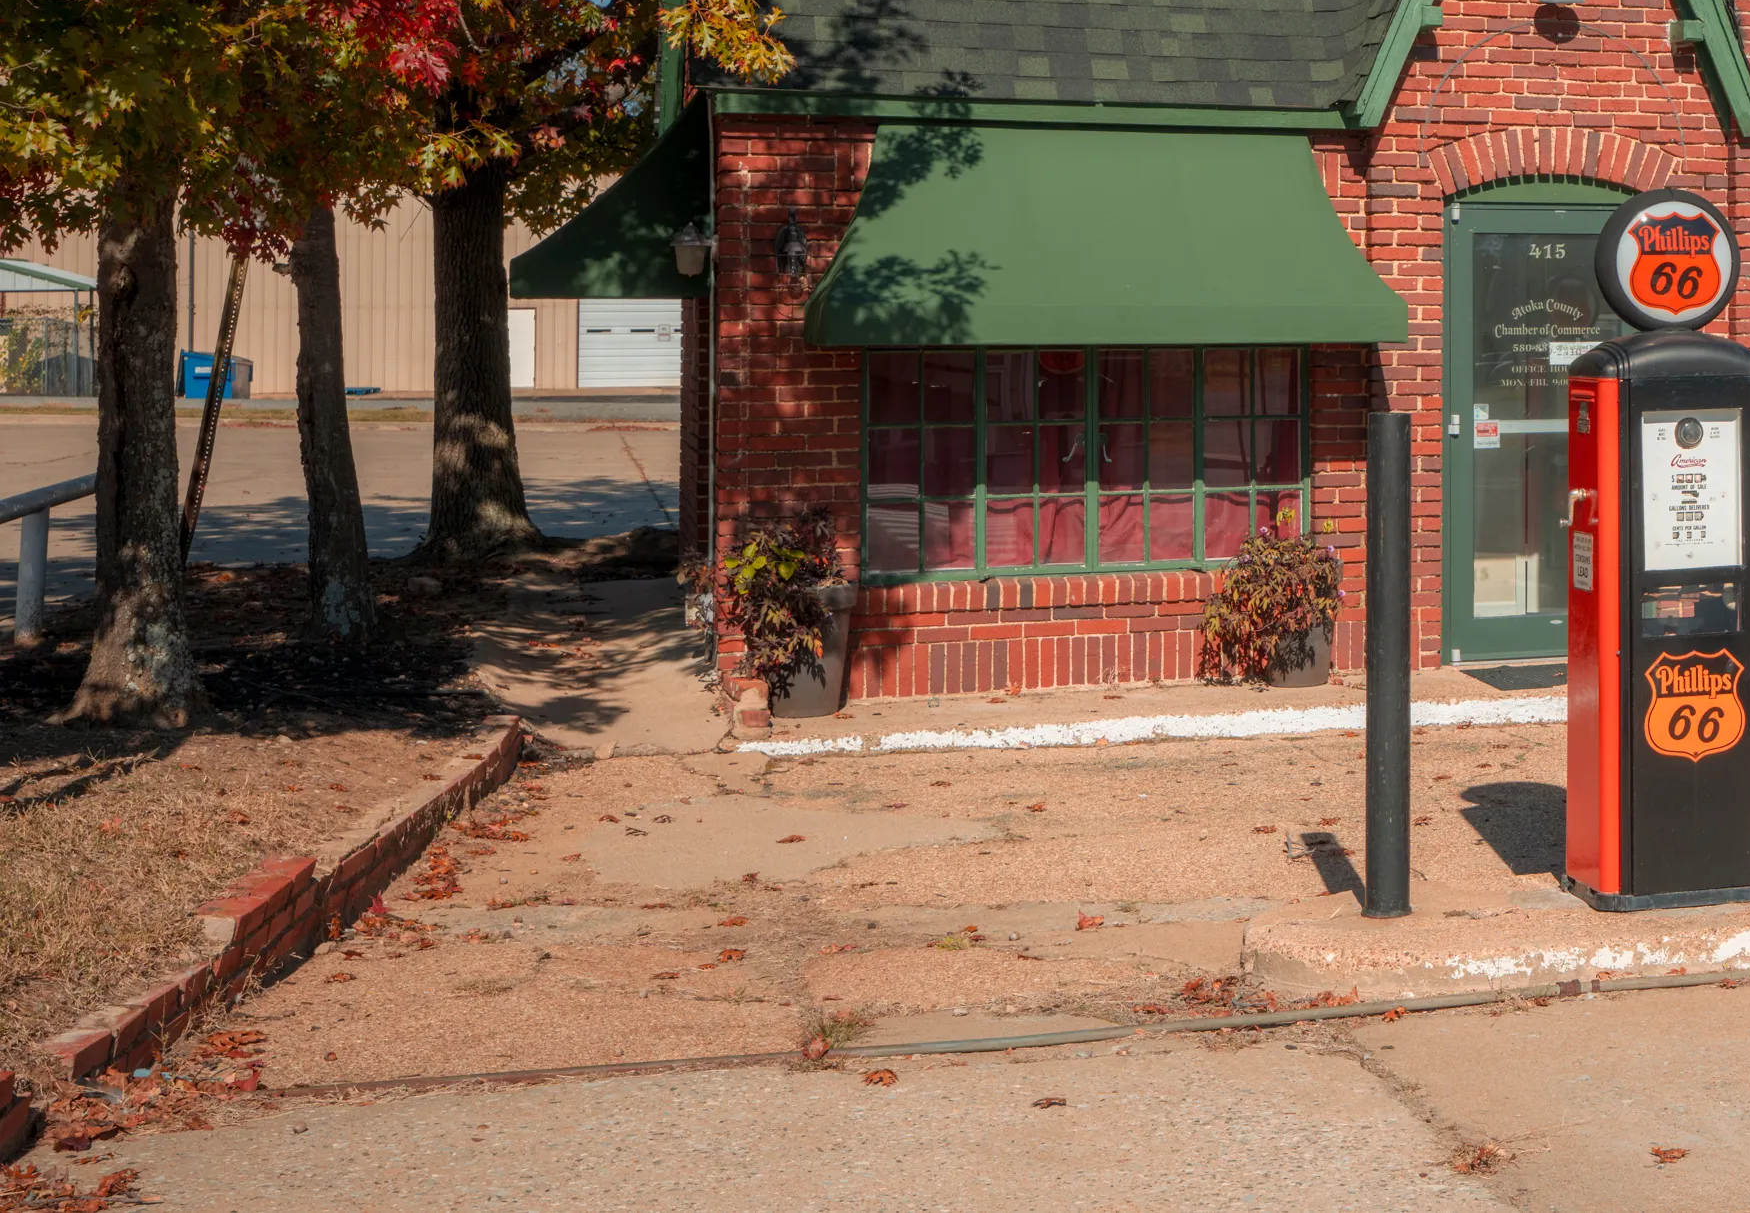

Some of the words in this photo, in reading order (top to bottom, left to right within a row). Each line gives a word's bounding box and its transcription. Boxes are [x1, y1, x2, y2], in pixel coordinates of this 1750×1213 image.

[1529, 243, 1566, 259] 415
[1638, 224, 1710, 259] Phillips
[1650, 262, 1703, 299] 66
[1511, 300, 1544, 320] Atoka
[1546, 298, 1584, 321] County
[1494, 323, 1537, 338] Chamber
[1540, 323, 1550, 335] of
[1550, 324, 1601, 338] Commerce
[1670, 454, 1707, 468] American
[1655, 664, 1732, 699] Phillips
[1668, 704, 1725, 743] 66
